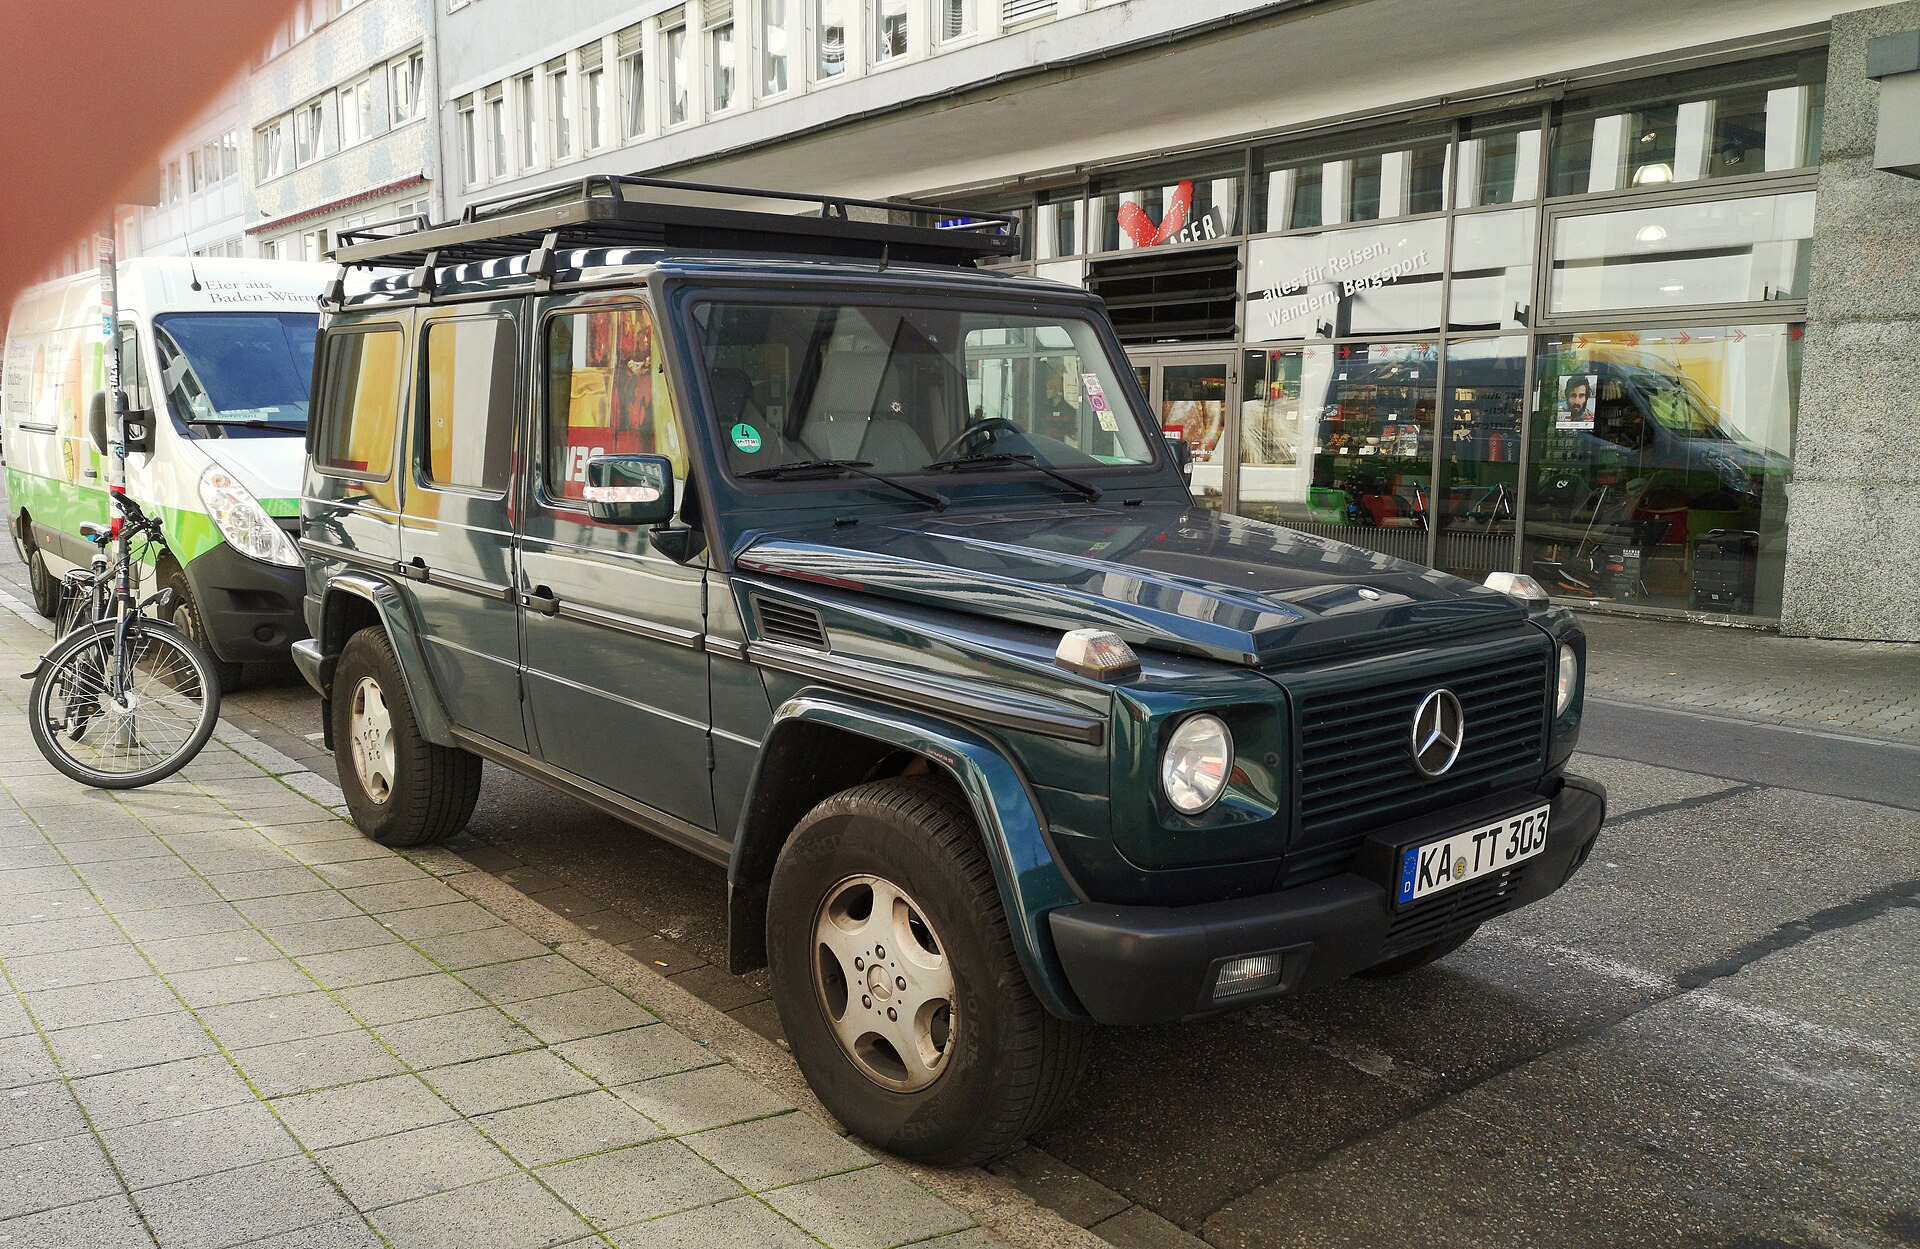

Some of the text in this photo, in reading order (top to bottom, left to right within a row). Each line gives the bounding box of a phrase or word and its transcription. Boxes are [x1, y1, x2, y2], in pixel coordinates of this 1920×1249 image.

[204, 280, 273, 291] Eier aus
[1262, 240, 1391, 303] alles für Reisen,
[1265, 250, 1430, 328] Wandern, Bergsport
[741, 424, 750, 438] 4
[1417, 810, 1548, 892] KA TT 303
[1404, 881, 1411, 893] D
